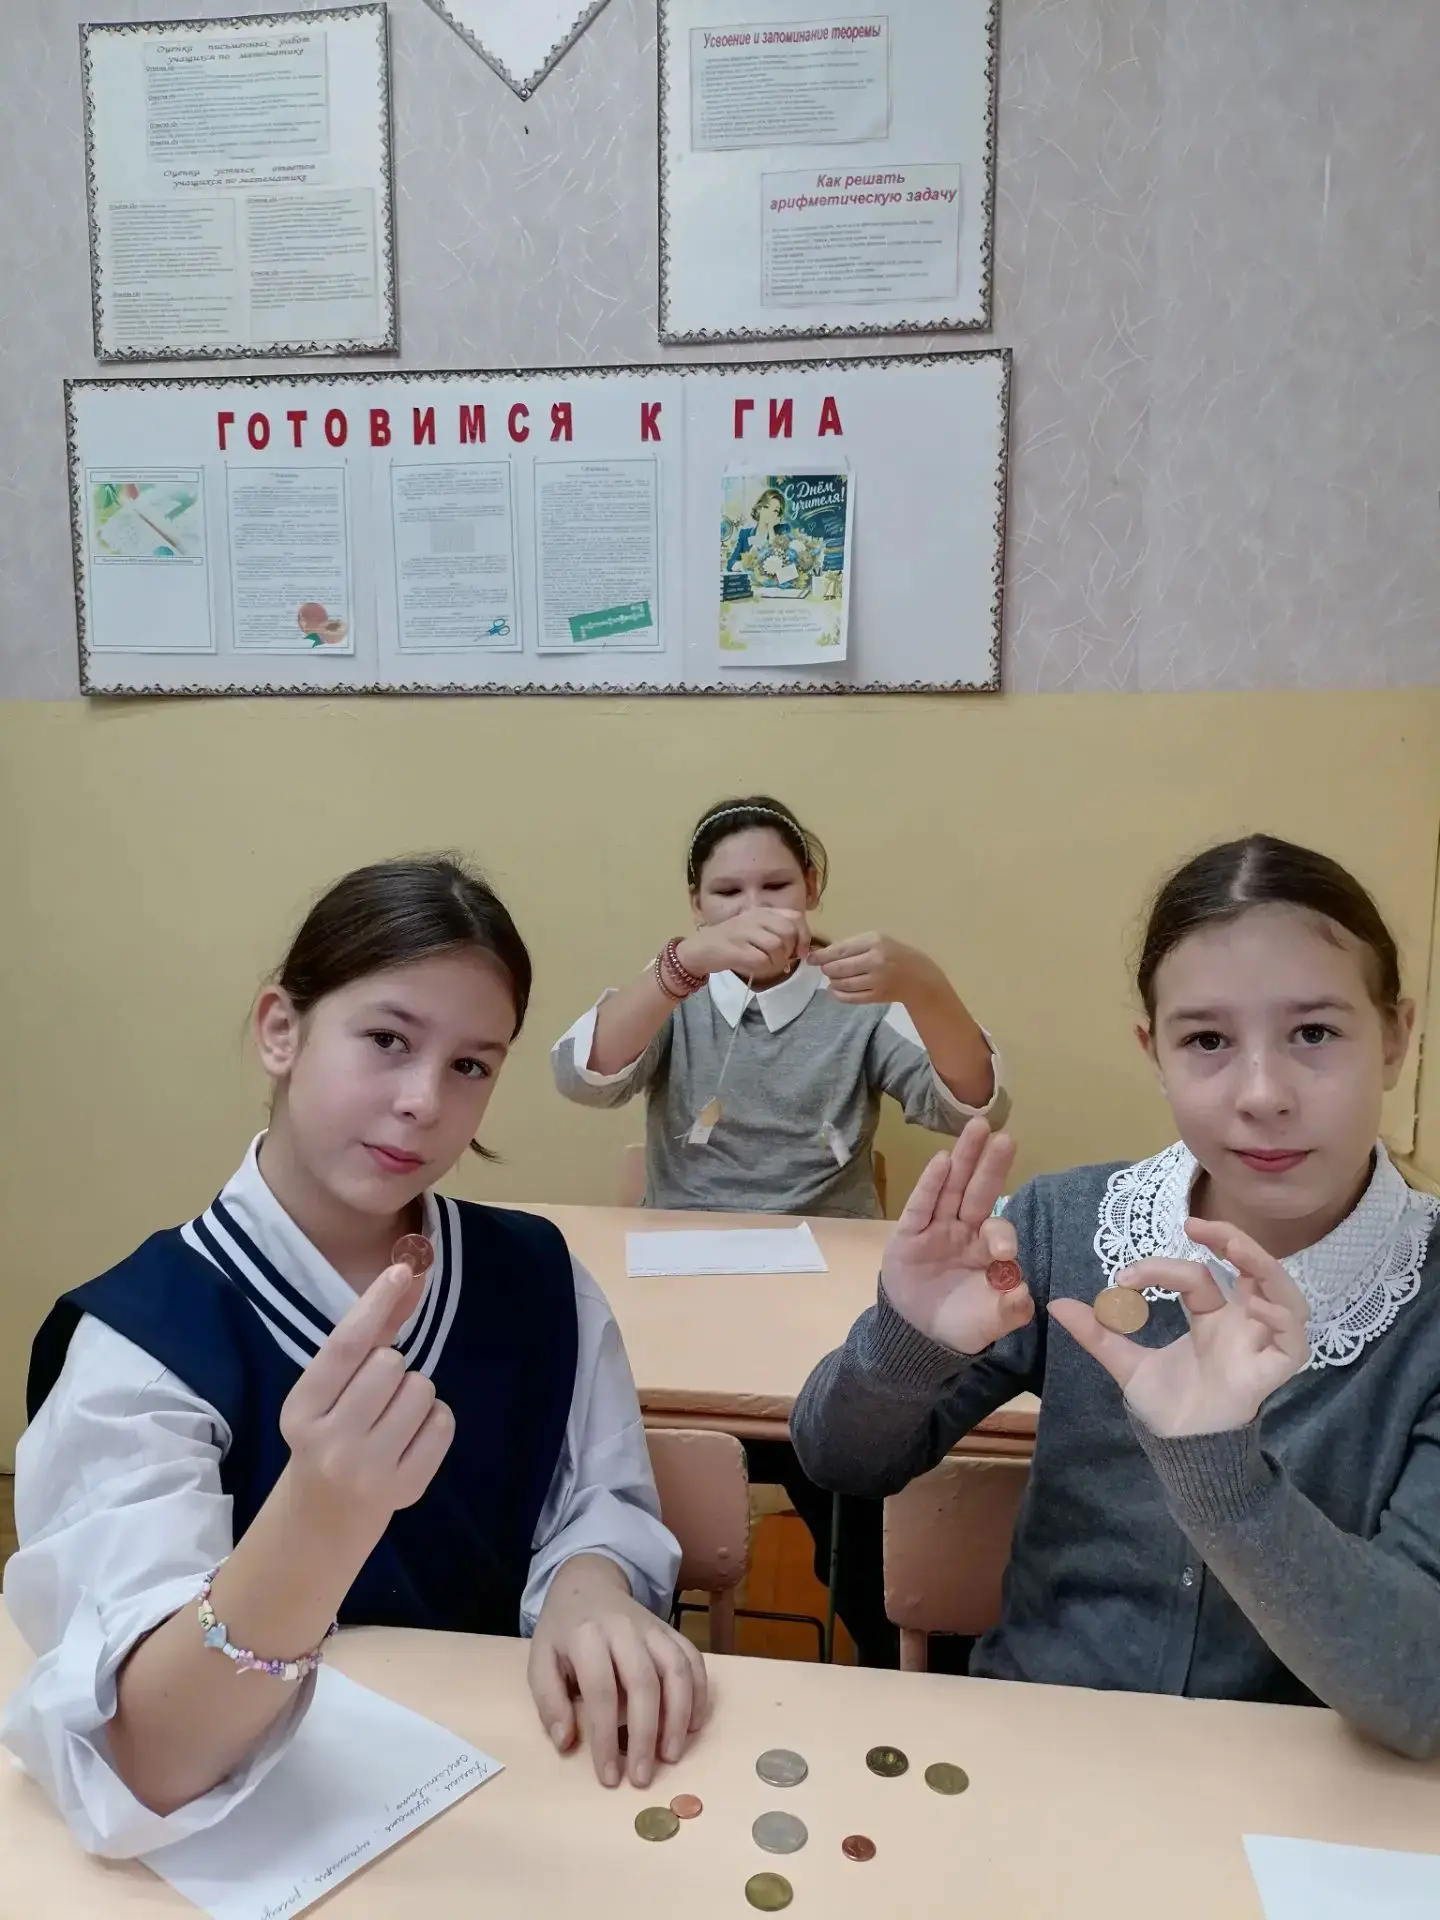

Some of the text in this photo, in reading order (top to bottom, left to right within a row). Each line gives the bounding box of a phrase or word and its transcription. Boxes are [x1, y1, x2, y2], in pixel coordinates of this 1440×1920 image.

[703, 24, 881, 49] Усвоение и запоминание теоремы
[816, 171, 906, 189] Как решать
[770, 186, 958, 214] арифметическую задачу
[217, 396, 843, 450] ГОТОВИМСЯ К ГИА
[784, 480, 836, 501] С Днём
[790, 486, 845, 521] учителя!
